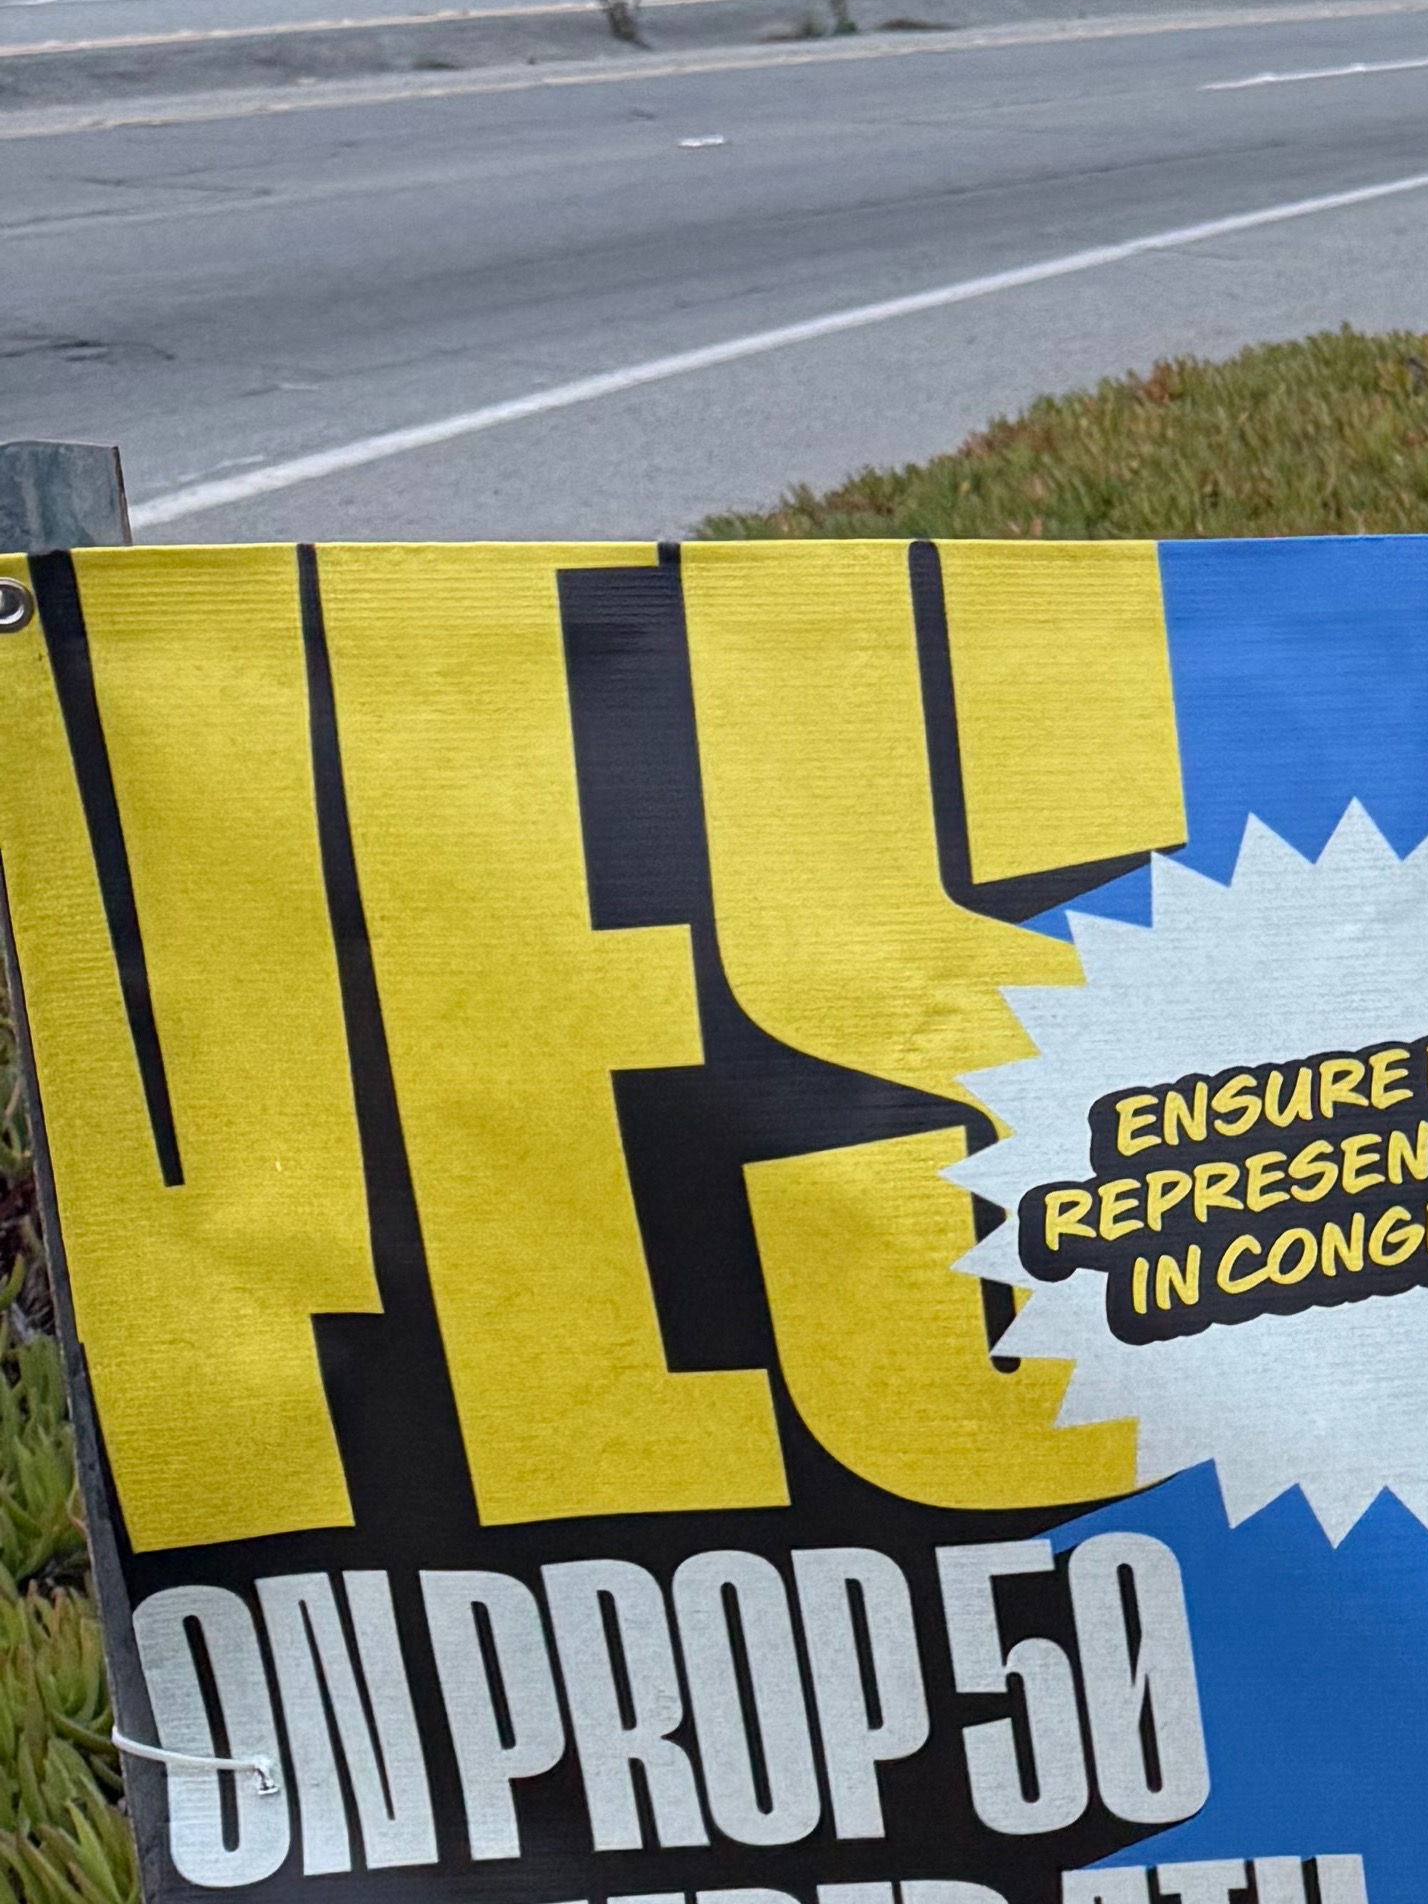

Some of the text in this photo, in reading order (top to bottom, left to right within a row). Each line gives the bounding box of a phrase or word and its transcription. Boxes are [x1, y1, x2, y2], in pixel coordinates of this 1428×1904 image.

[0, 539, 1188, 1552] YES
[1115, 1049, 1414, 1158] ENSURE
[1131, 1244, 1202, 1314] IN
[132, 1532, 1210, 1888] ON PROP 50
